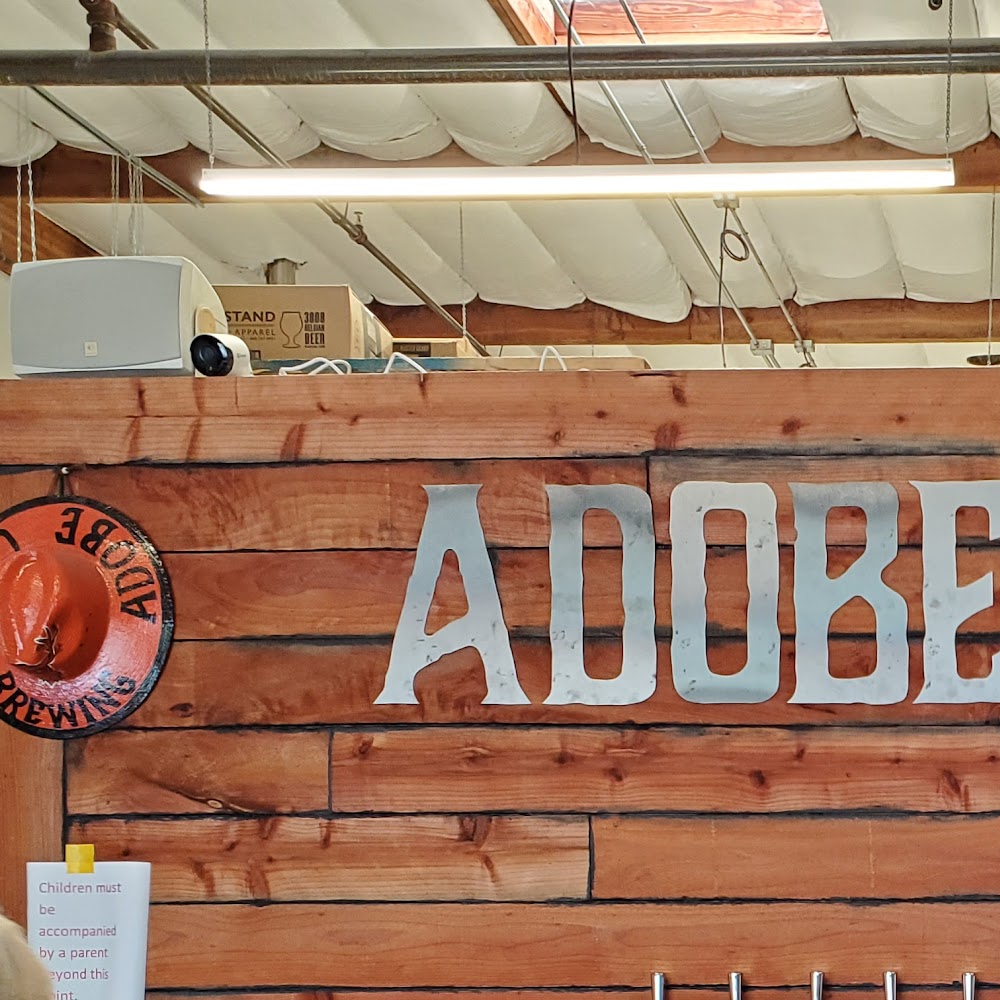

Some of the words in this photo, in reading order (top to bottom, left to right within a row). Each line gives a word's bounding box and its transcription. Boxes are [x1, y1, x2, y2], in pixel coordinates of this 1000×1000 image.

[235, 328, 276, 336] APPAREL
[55, 507, 157, 624] ADOBE
[39, 882, 93, 894] Children
[96, 882, 122, 893] must
[39, 904, 56, 915] be
[39, 925, 117, 939] accompanied
[39, 947, 54, 961] by
[58, 949, 66, 958] a
[70, 948, 108, 961] parent
[50, 967, 87, 983] eyond
[90, 968, 109, 980] this
